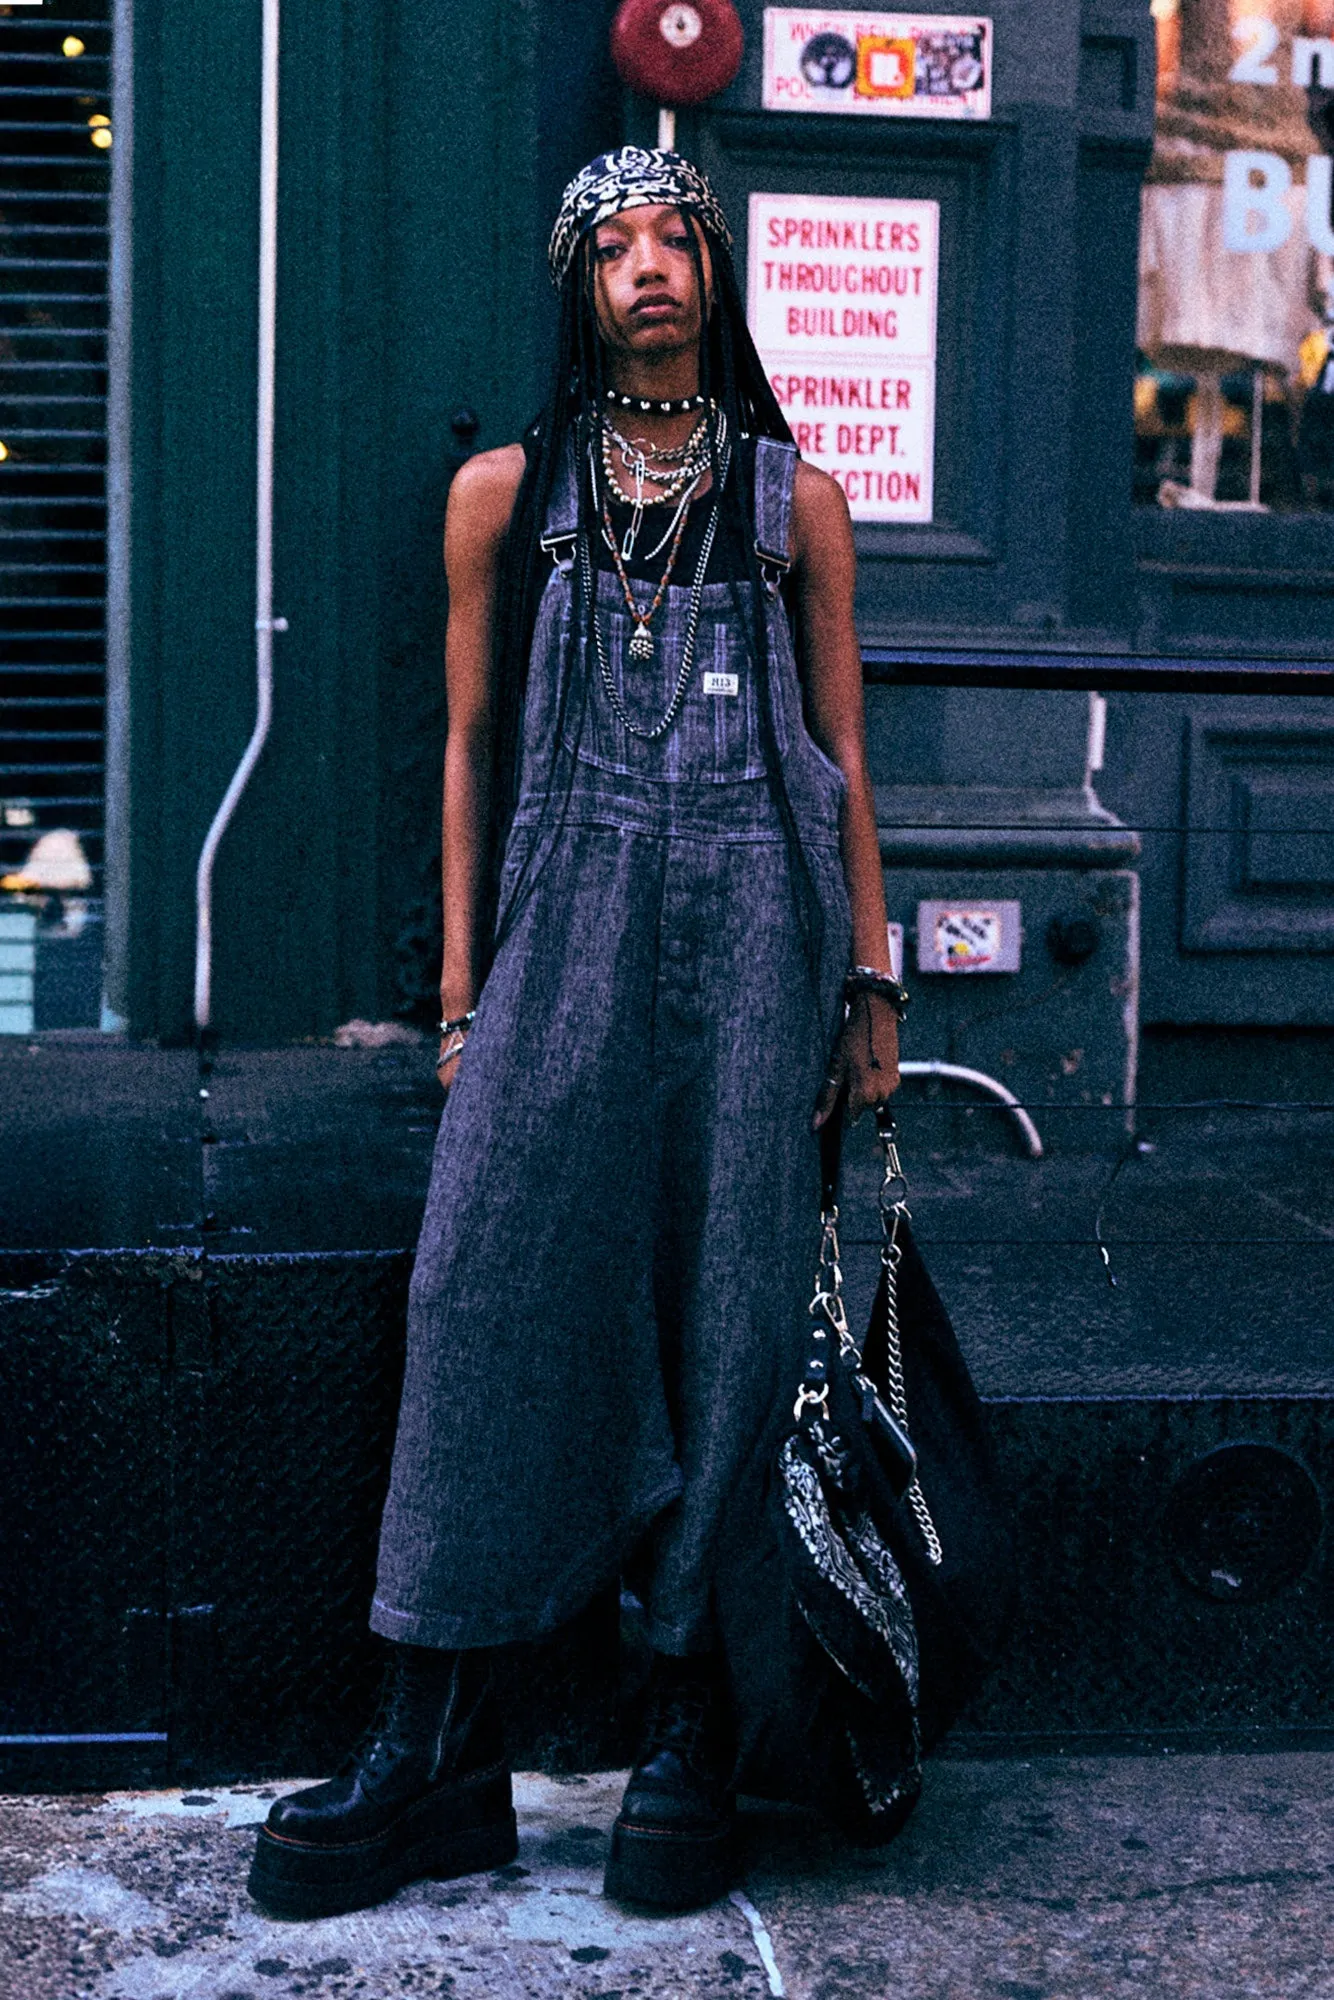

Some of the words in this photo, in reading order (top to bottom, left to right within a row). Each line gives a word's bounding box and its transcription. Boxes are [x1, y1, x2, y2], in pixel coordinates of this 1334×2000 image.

[767, 217, 920, 253] SPRINKLERS
[763, 261, 923, 296] THROUGHOUT
[787, 306, 898, 339] BUILDING
[771, 374, 911, 410] SPRINKLER
[789, 421, 827, 454] RE
[837, 424, 906, 457] DEPT.
